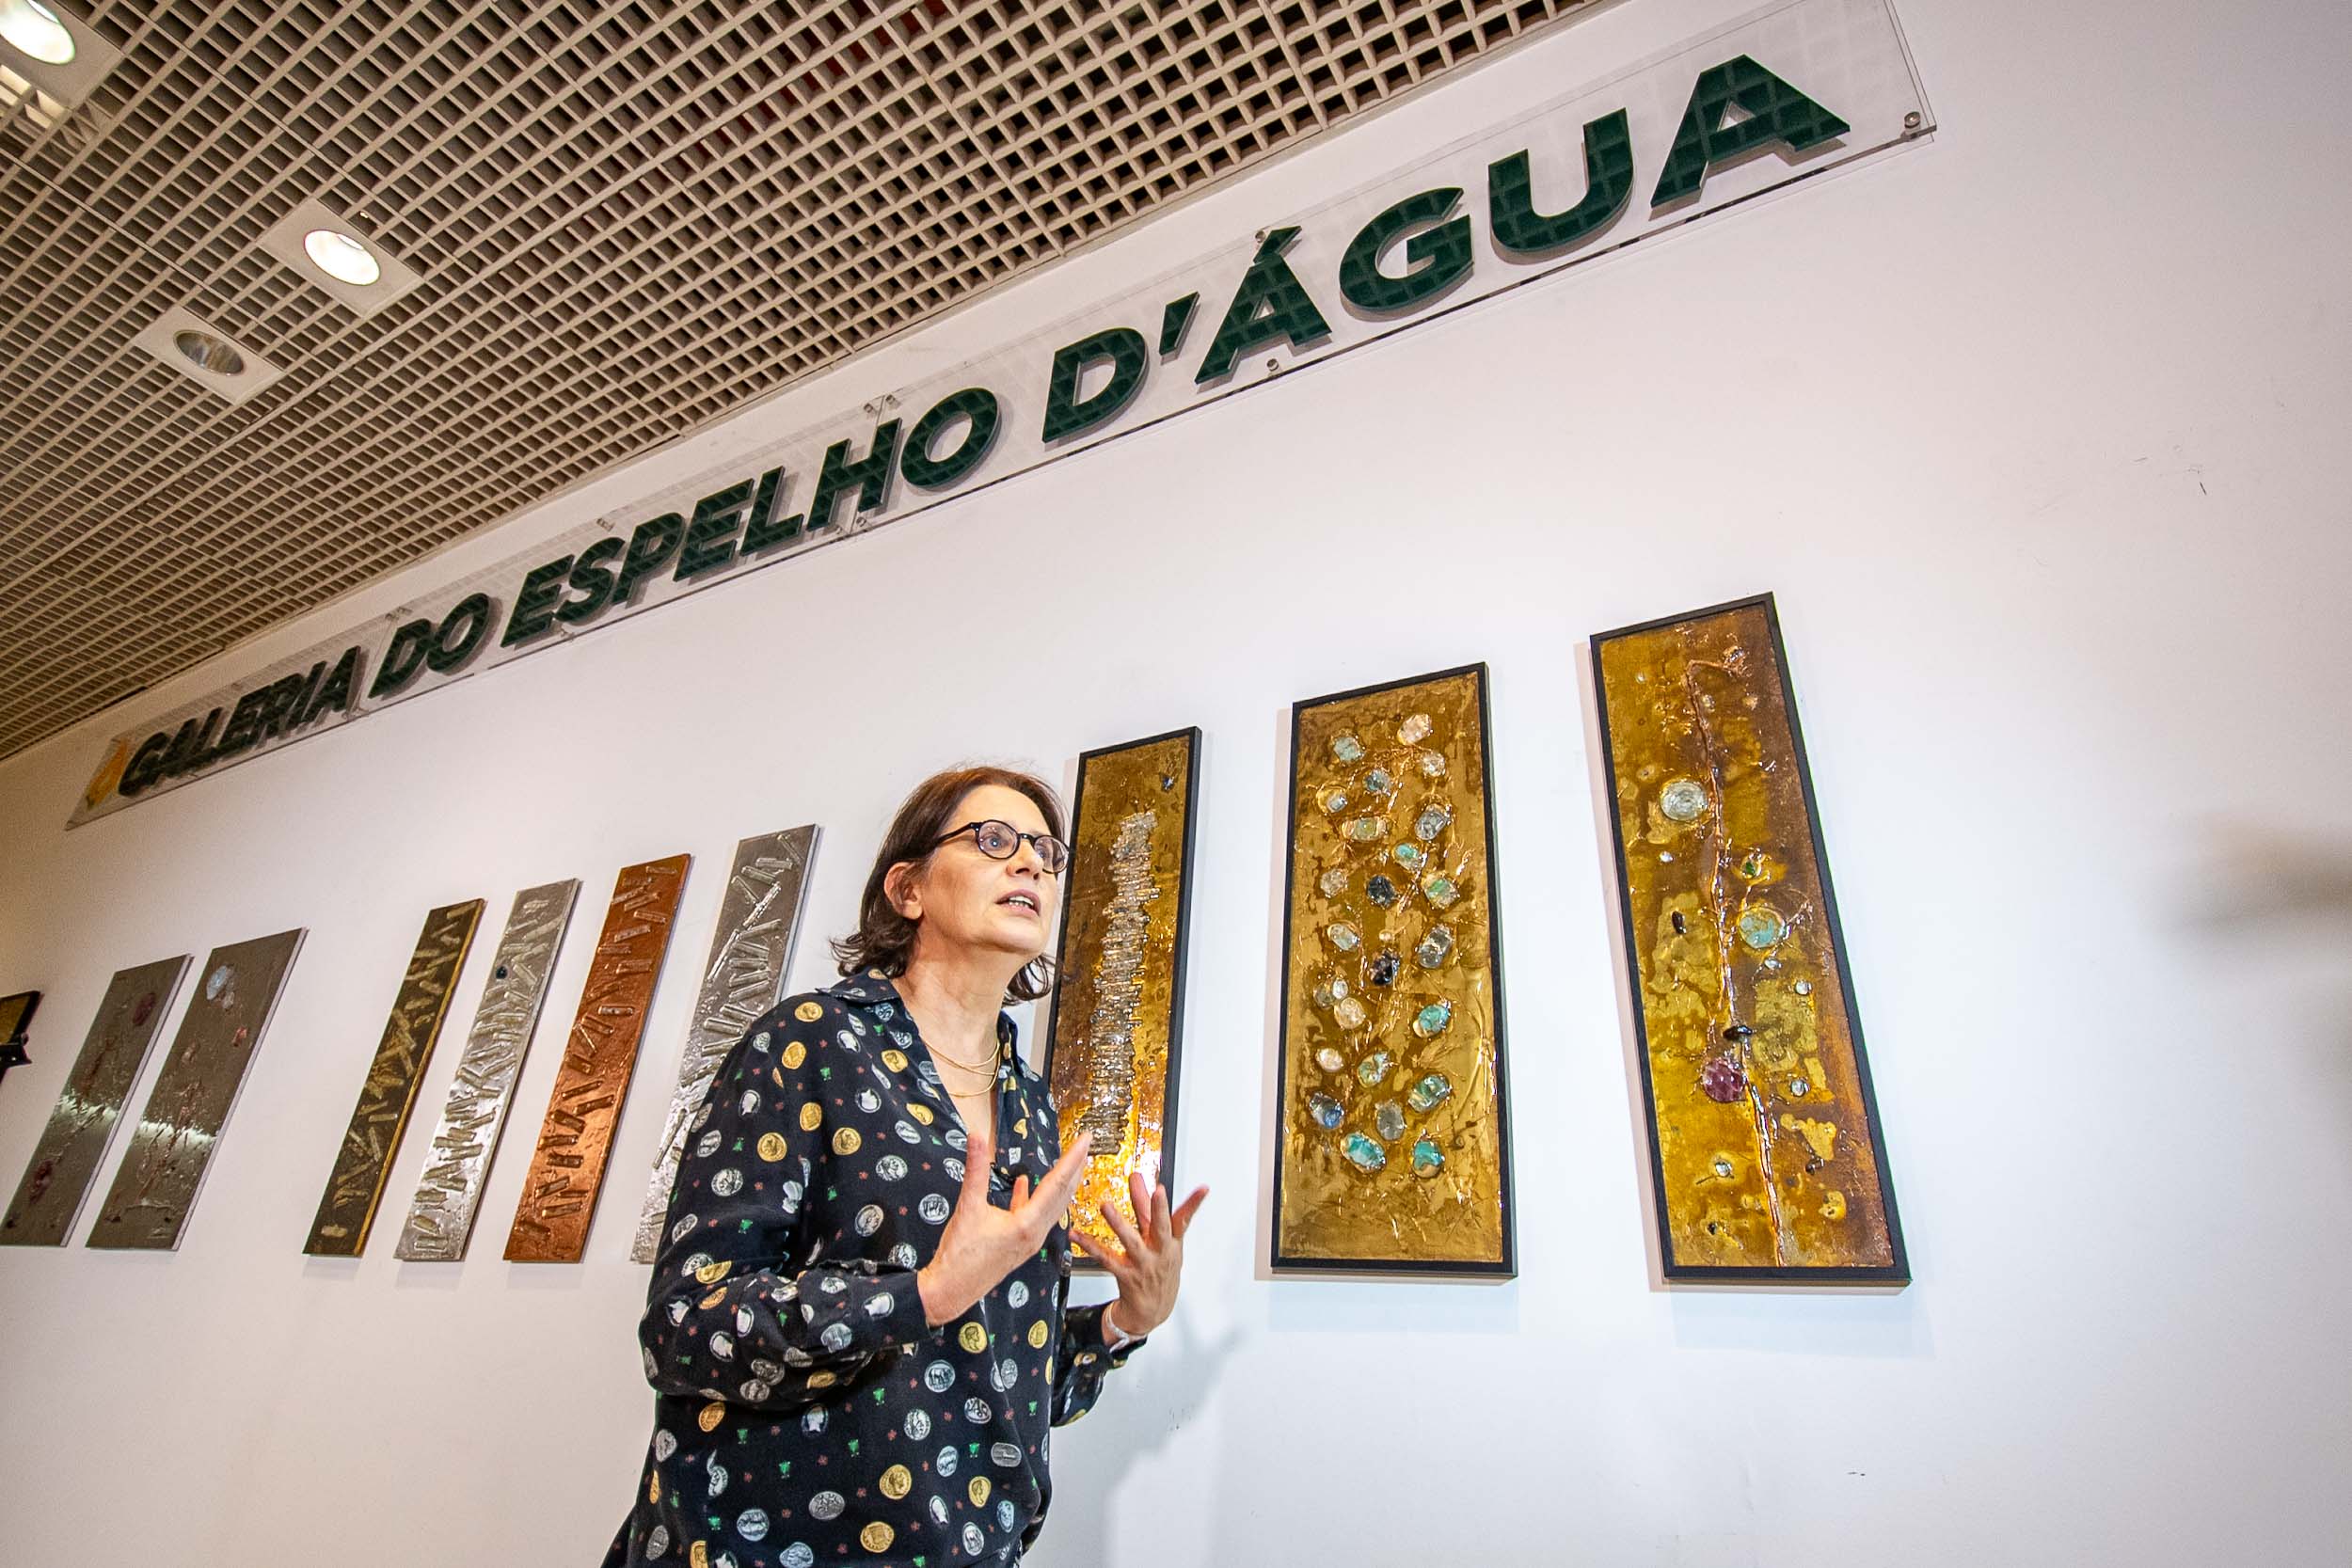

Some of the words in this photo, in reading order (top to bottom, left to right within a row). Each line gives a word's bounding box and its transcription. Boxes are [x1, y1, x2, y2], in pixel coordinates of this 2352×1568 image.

[118, 645, 362, 796] GALERIA
[369, 593, 491, 698] DO
[501, 387, 1000, 647] ESPELHO
[1041, 54, 1851, 443] D'ÁGUA
